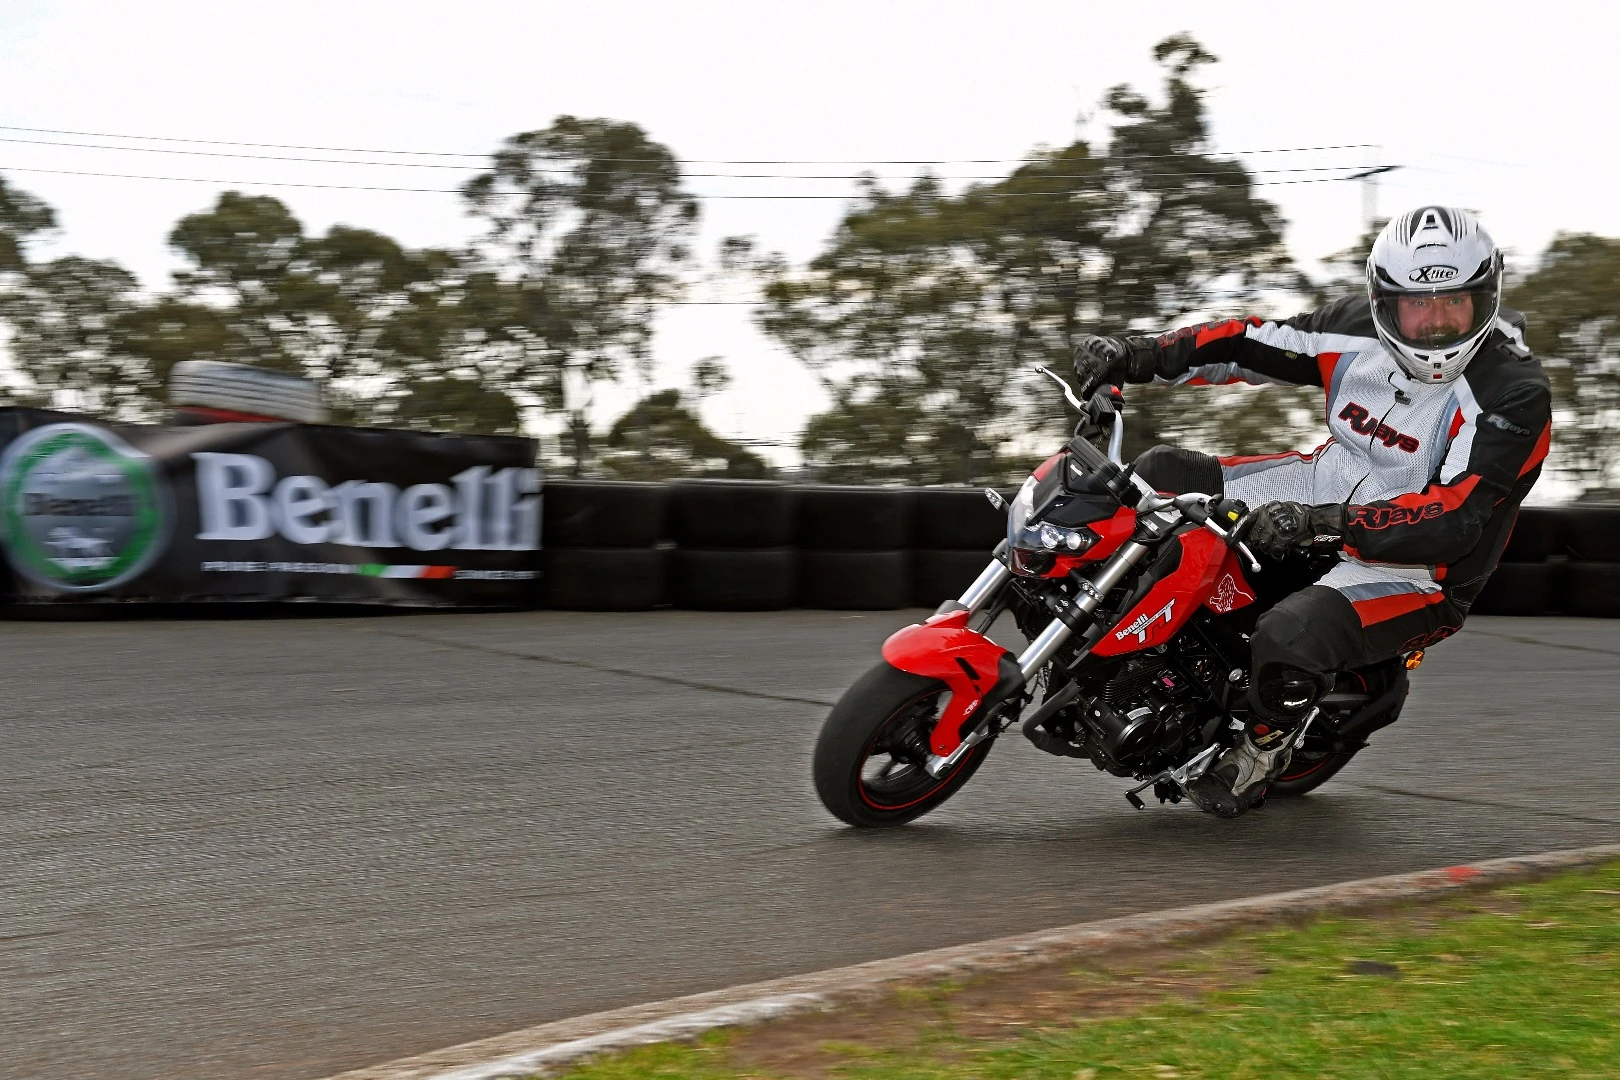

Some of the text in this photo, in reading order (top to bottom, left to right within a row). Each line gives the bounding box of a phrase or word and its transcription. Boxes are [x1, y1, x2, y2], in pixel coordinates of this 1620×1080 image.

[1414, 266, 1454, 281] X-lite
[190, 451, 543, 551] Benelli
[1115, 613, 1149, 641] Benelli
